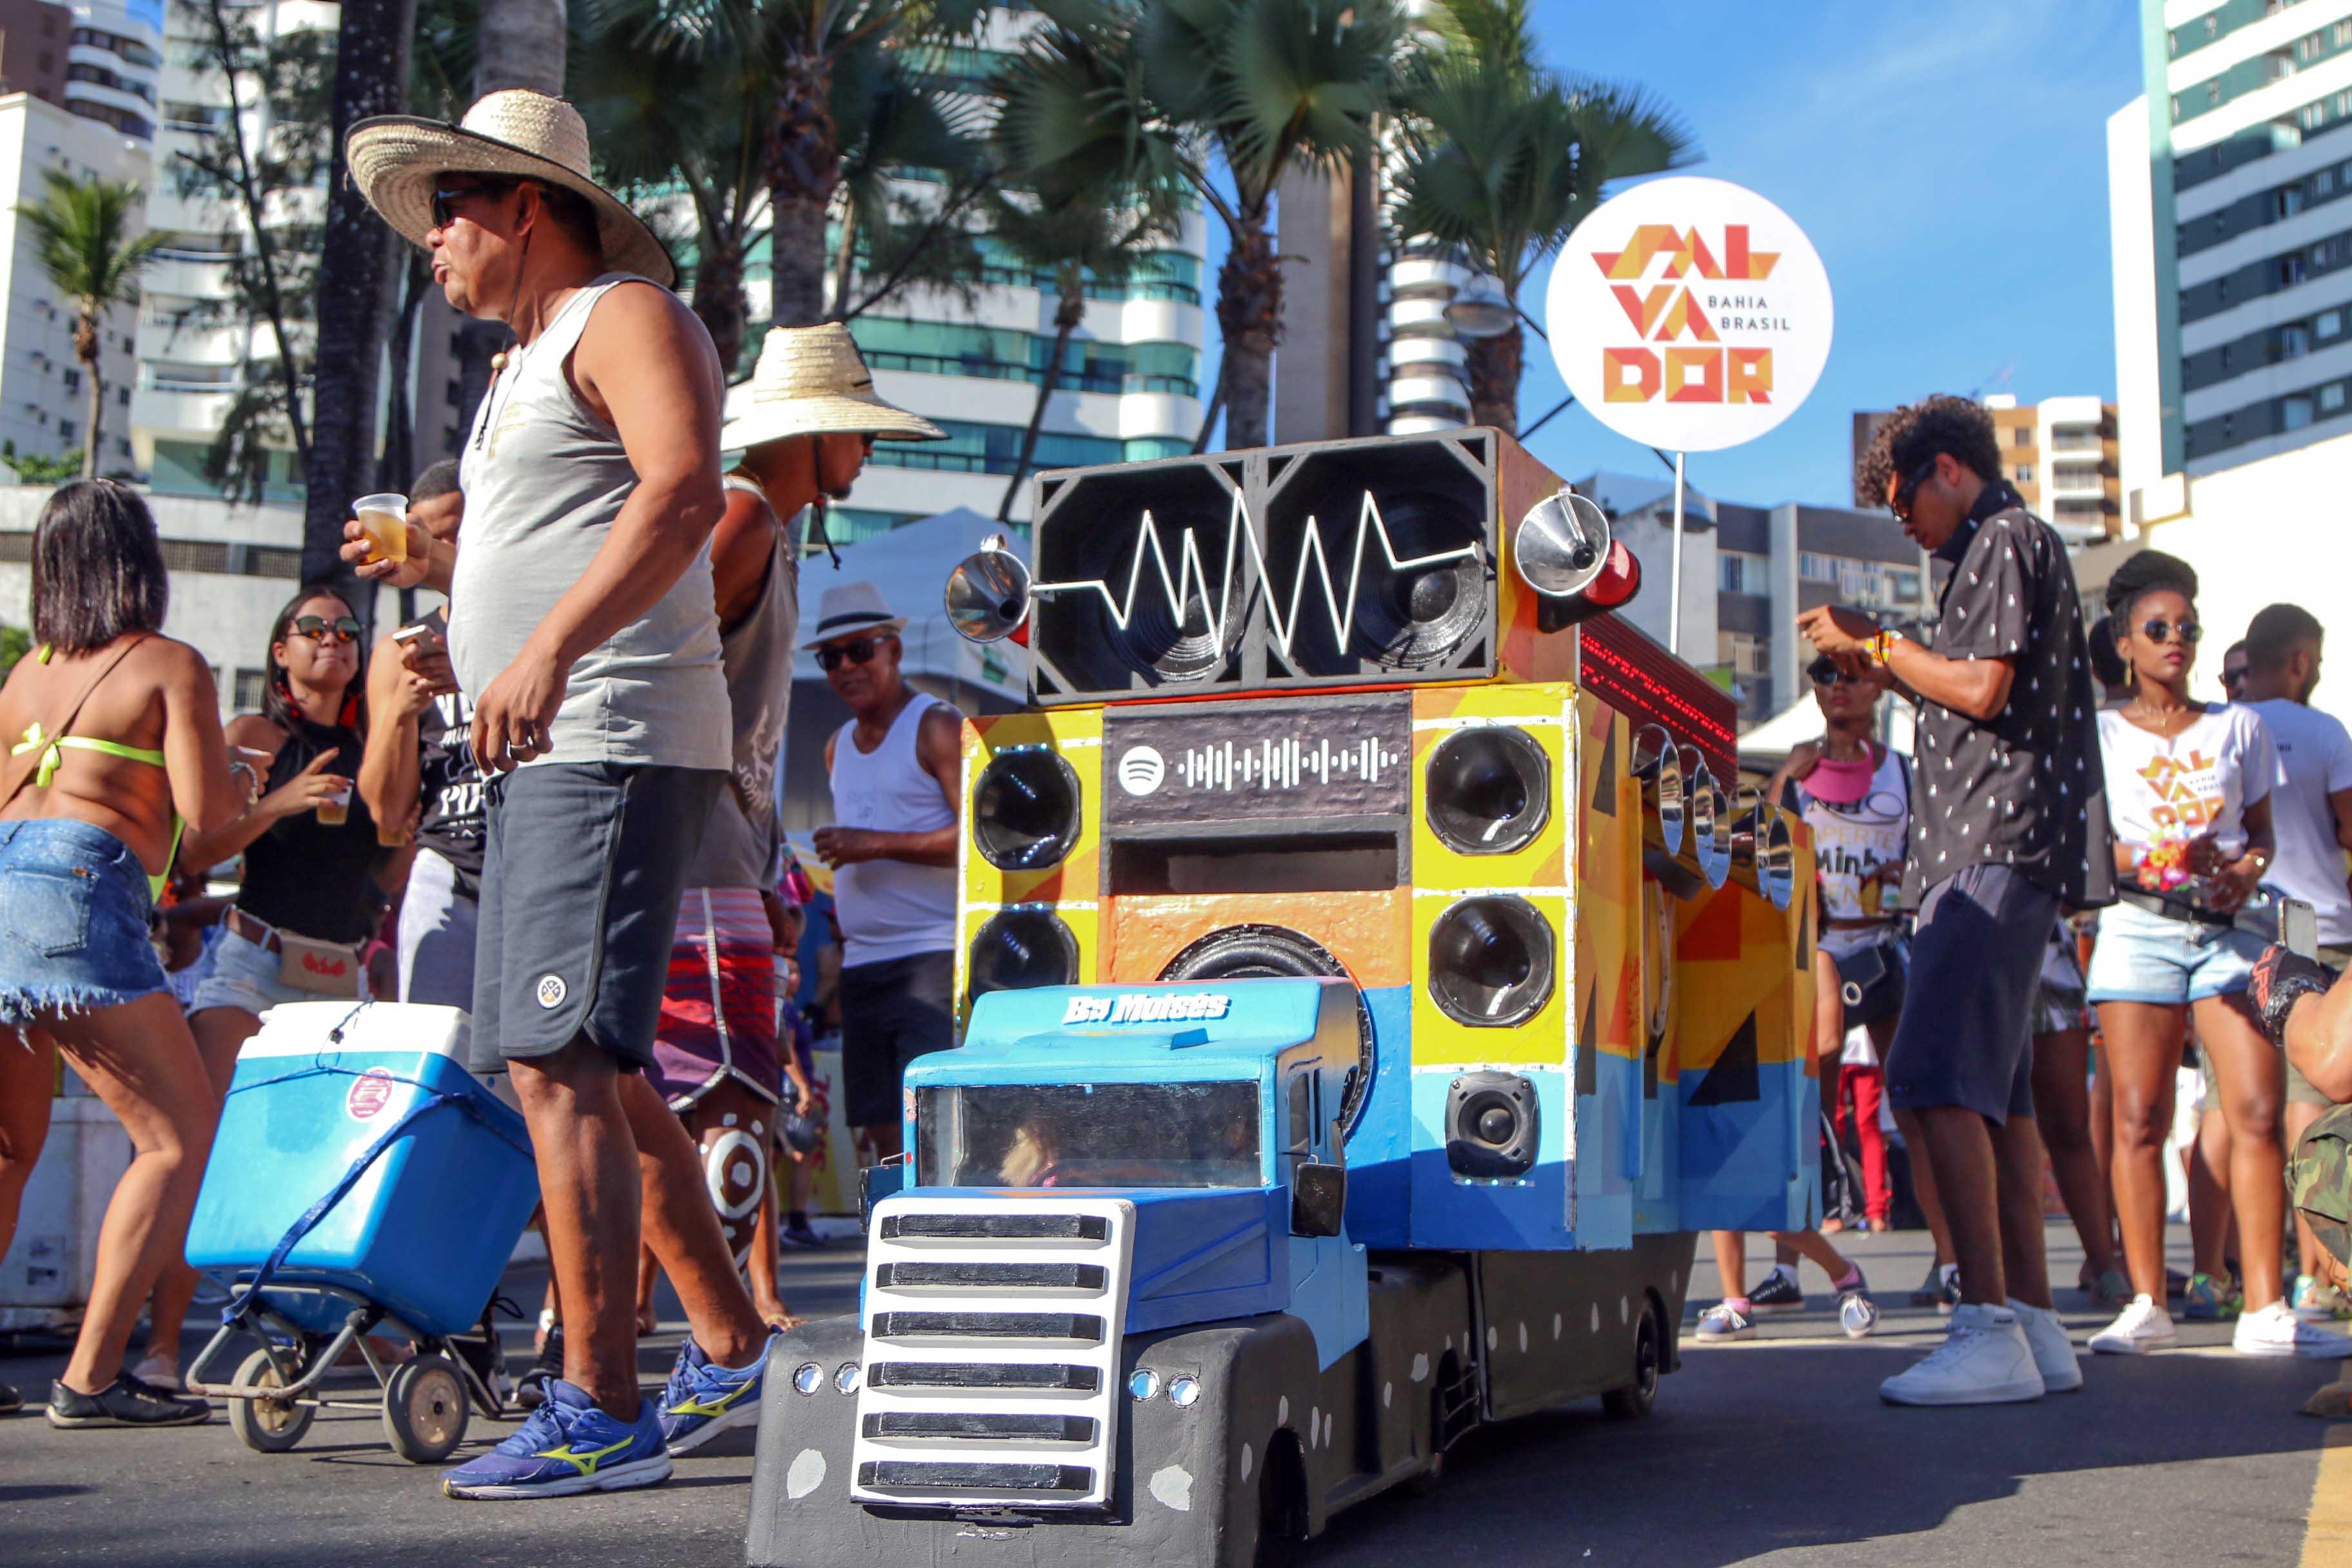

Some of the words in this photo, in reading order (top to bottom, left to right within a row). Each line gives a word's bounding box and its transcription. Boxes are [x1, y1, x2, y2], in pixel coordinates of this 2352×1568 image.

[1708, 295, 1768, 309] BAHIA
[1721, 317, 1790, 330] BRASIL
[1603, 347, 1774, 404] DOR
[1062, 995, 1114, 1025] By
